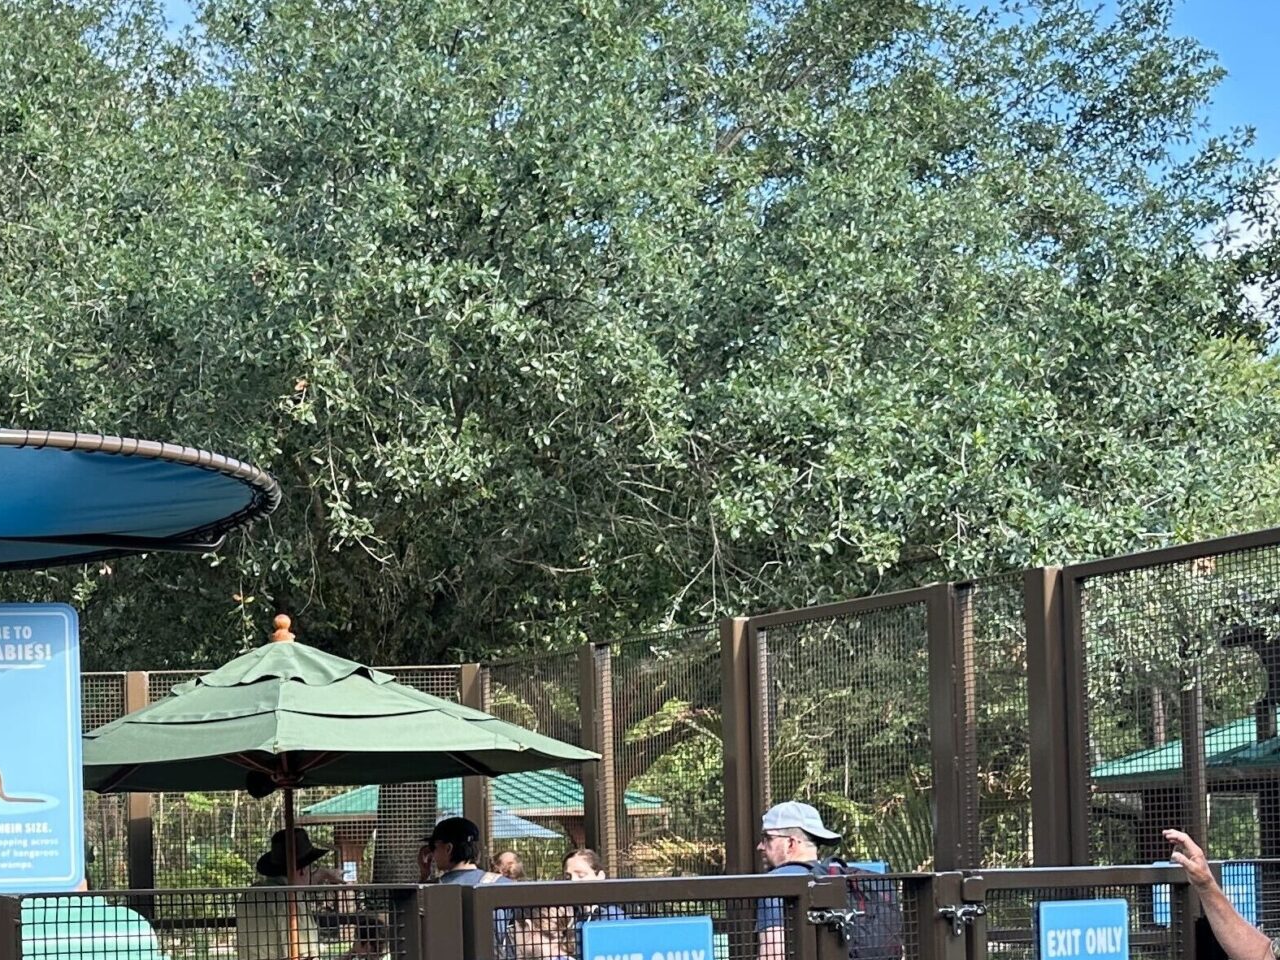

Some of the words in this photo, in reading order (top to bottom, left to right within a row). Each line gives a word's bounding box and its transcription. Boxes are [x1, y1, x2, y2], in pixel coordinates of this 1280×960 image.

[13, 625, 33, 639] TO
[24, 822, 53, 834] SIZE.
[30, 838, 59, 846] across
[0, 849, 11, 858] of
[13, 849, 59, 859] kangaroos
[1047, 928, 1081, 958] EXIT
[1085, 926, 1123, 955] ONLY
